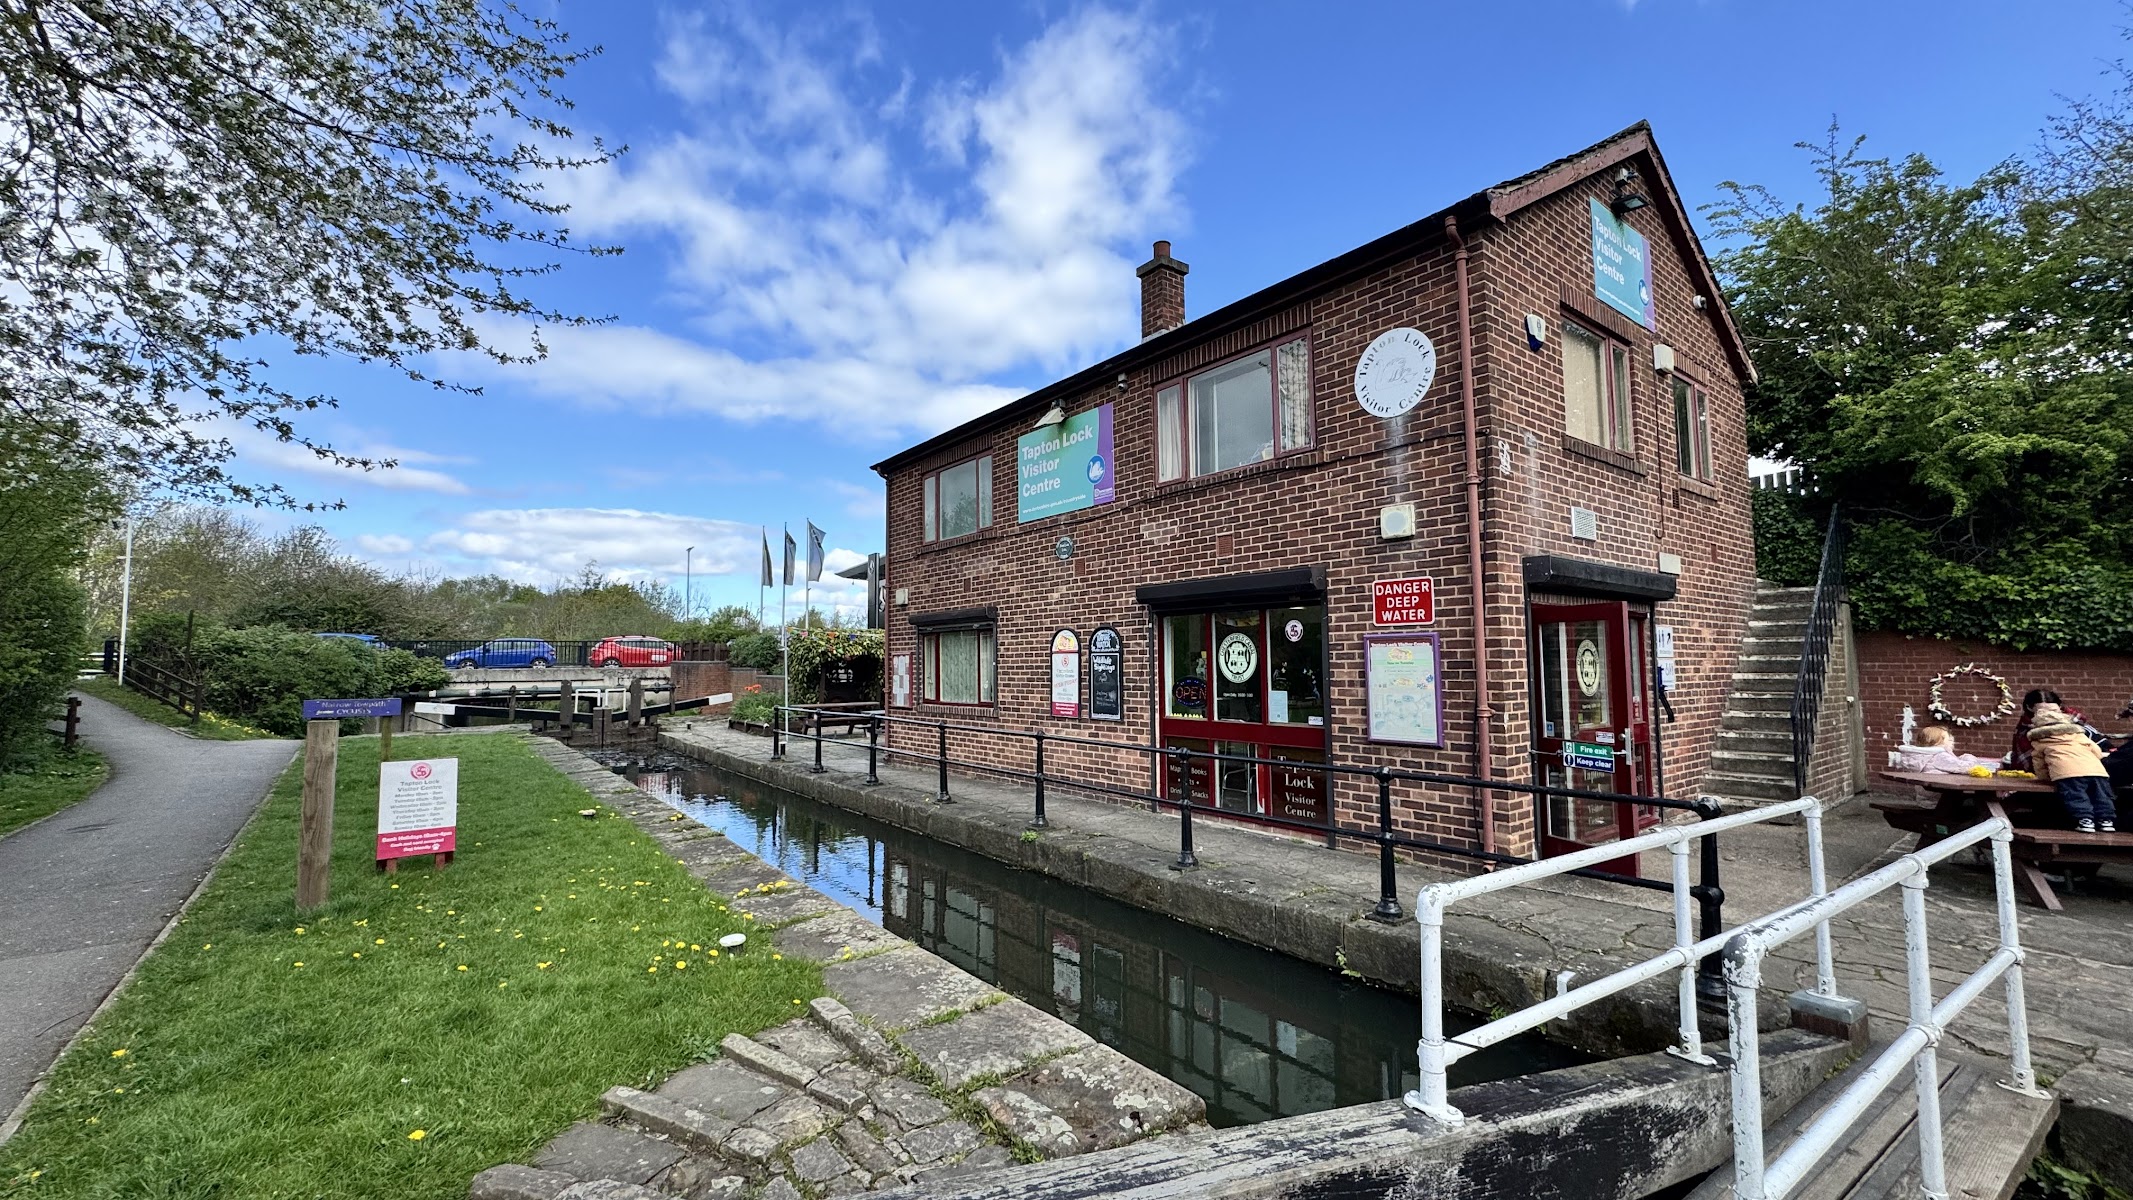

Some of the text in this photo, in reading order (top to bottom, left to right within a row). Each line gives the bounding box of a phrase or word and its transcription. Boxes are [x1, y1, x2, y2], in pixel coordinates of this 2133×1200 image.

[1594, 215, 1641, 262] Tapton Lock
[1595, 235, 1622, 265] Visitor
[1596, 256, 1624, 285] Centre
[1359, 333, 1430, 379] Tapton Lock
[1361, 366, 1431, 413] Visitor Centre
[1022, 425, 1093, 460] Tapton Lock
[1022, 458, 1060, 478] Visitor
[1022, 477, 1061, 498] Centre
[1375, 581, 1430, 596] DANGER
[1386, 596, 1419, 608] DEEP
[1382, 609, 1425, 621] WATER
[1175, 687, 1207, 699] OPEN
[1580, 746, 1593, 754] Fire
[1576, 757, 1612, 769] Keep clear
[1191, 767, 1207, 776] Books
[1285, 773, 1315, 789] Lock
[1191, 790, 1209, 799] Snacks
[1285, 791, 1316, 806] Visitor
[1285, 804, 1316, 818] Centre
